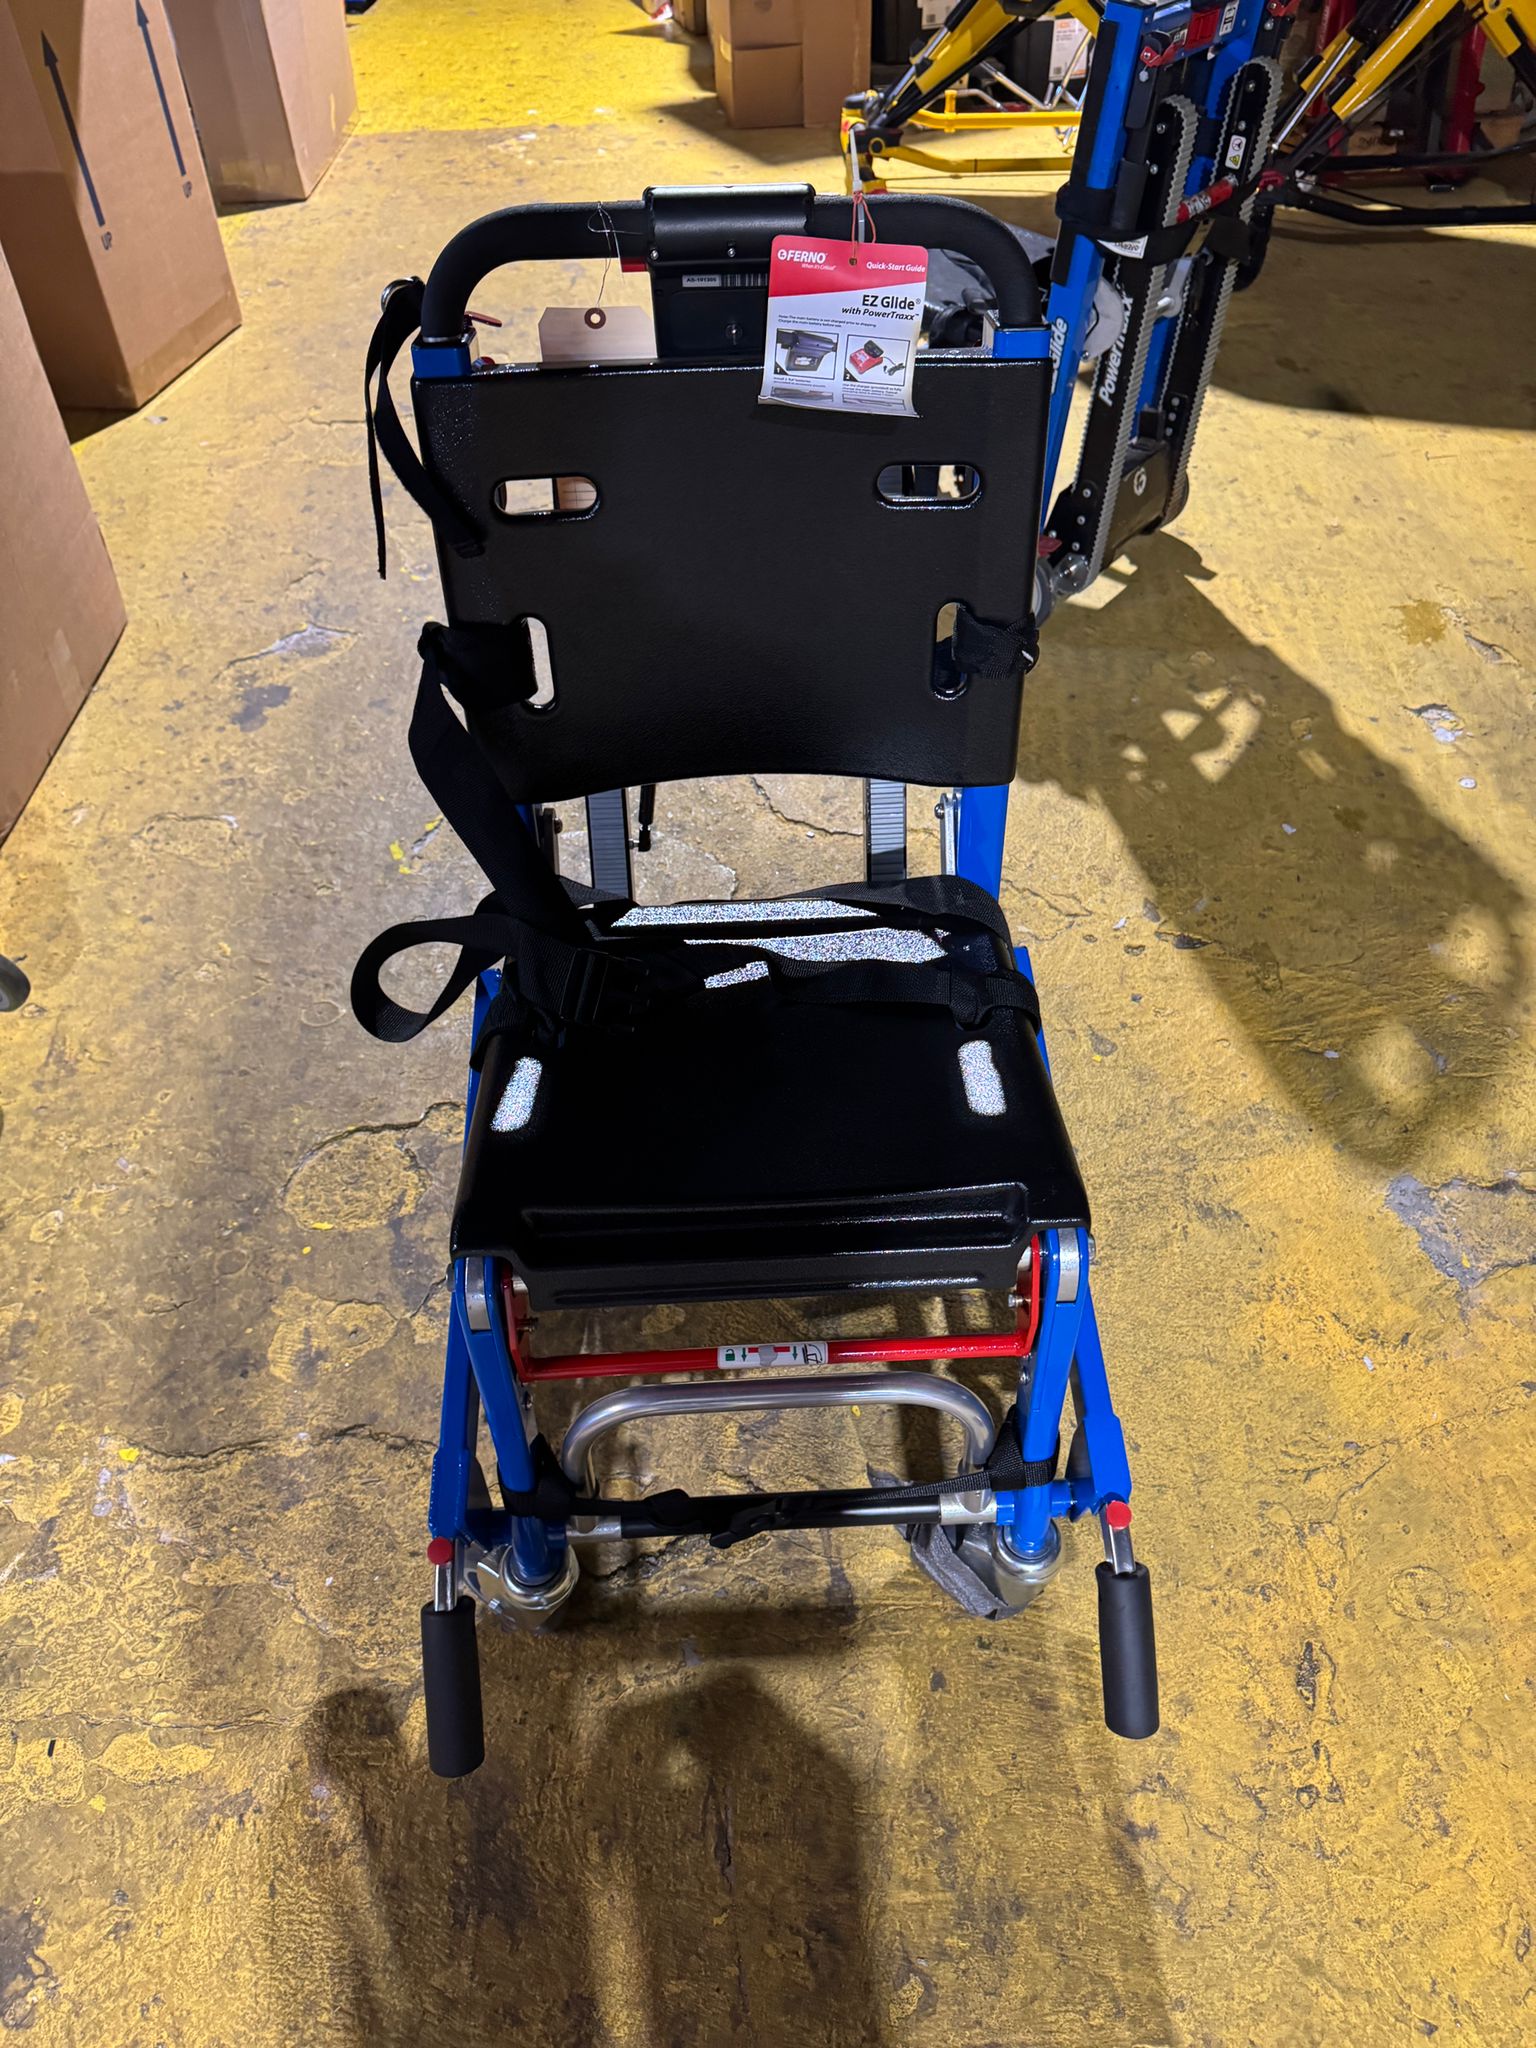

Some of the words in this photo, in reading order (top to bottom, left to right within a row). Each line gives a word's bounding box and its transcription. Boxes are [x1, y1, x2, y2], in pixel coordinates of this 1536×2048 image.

[101, 231, 112, 250] UP
[787, 250, 826, 264] FERNO
[866, 261, 904, 271] Quick-Start
[905, 264, 926, 273] Guide
[862, 294, 878, 307] EZ
[841, 306, 861, 316] with
